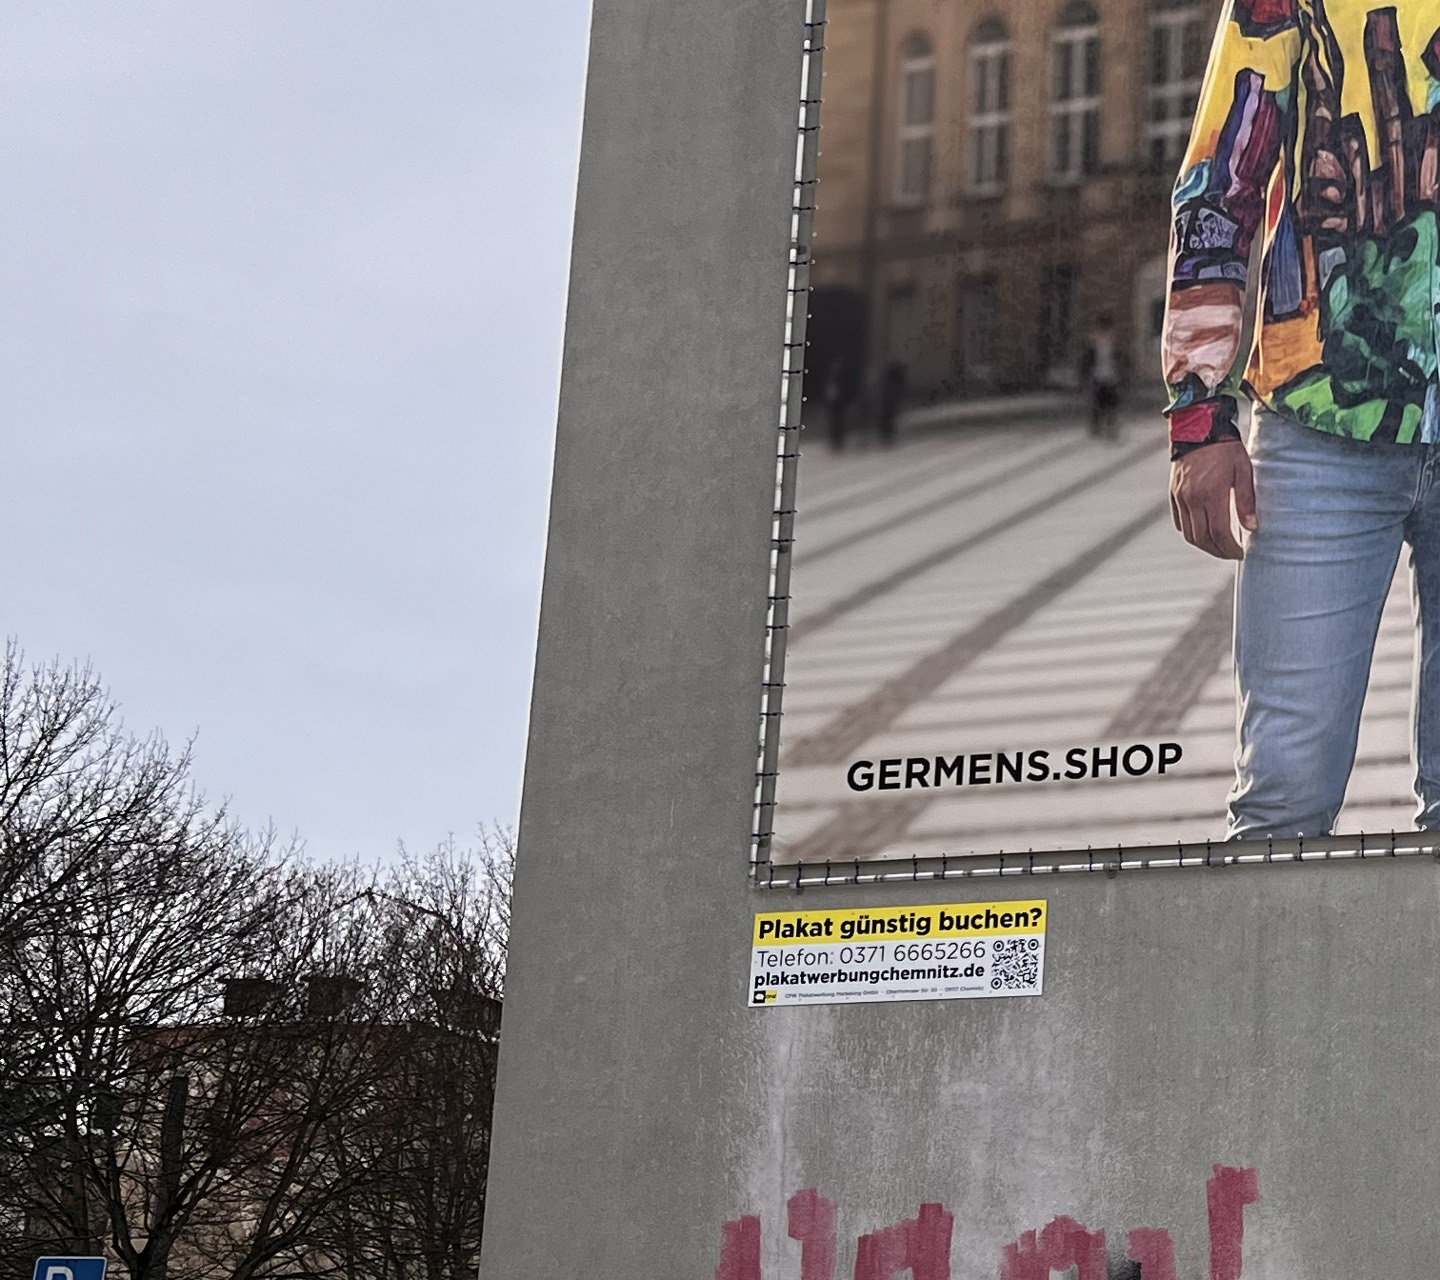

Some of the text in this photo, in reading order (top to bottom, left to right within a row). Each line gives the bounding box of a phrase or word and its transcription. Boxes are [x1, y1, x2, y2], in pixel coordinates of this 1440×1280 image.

[847, 742, 1183, 792] GERMENS.SHOP
[758, 907, 1043, 939] Plakat günstig buchen?
[757, 941, 986, 968] Telefon: 0371 6665266
[754, 965, 985, 989] plakatwerbungchemnitz.de
